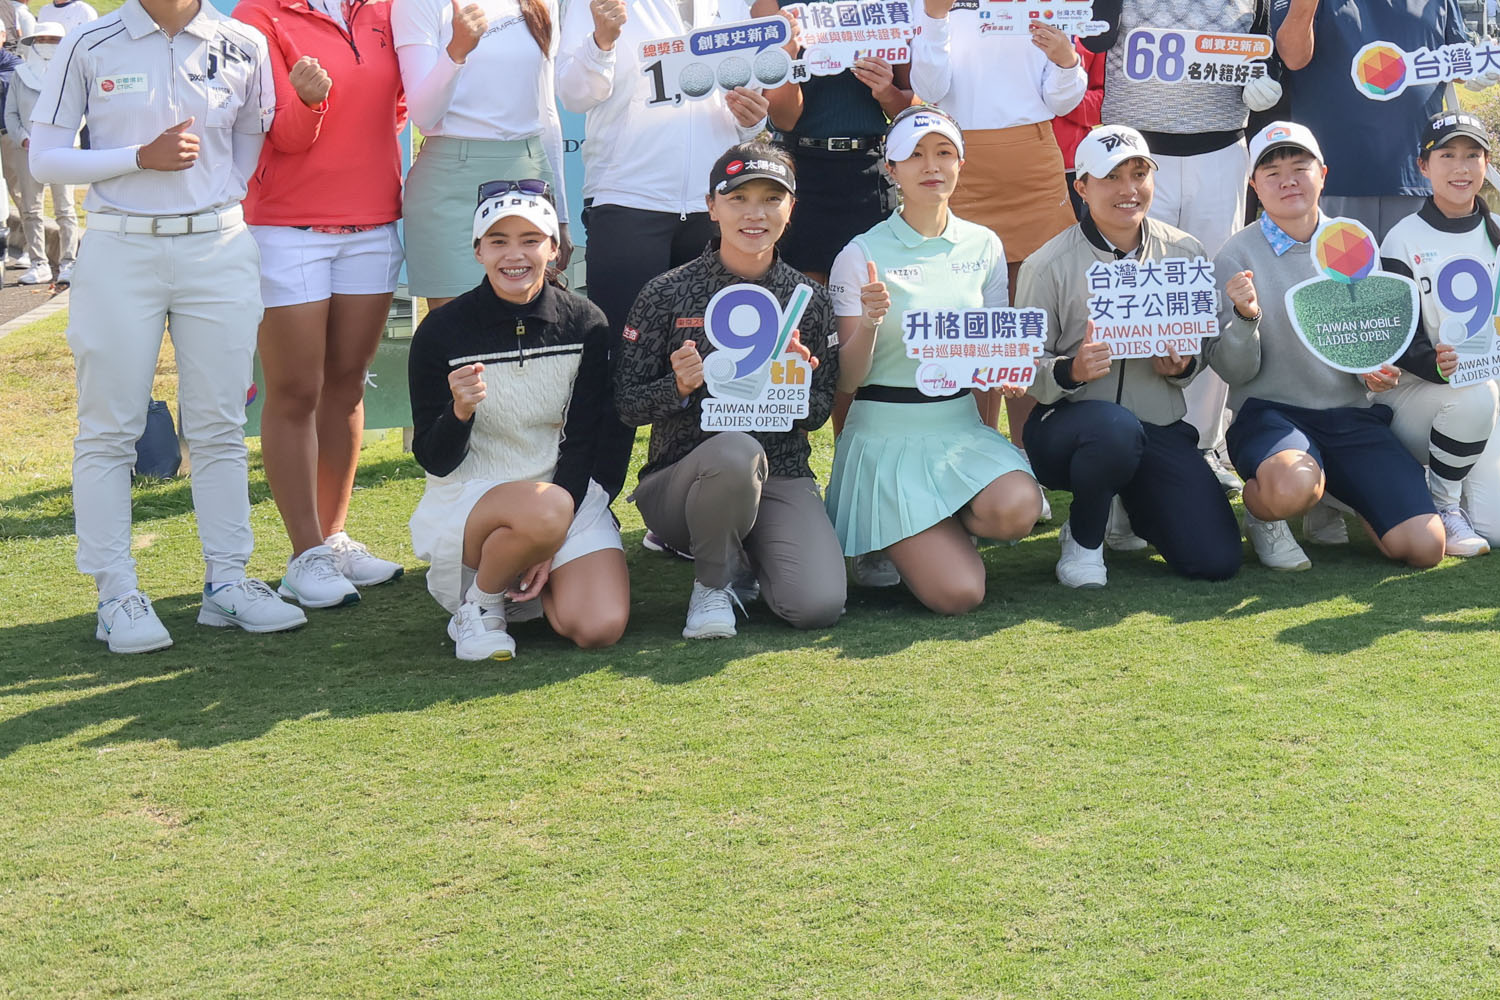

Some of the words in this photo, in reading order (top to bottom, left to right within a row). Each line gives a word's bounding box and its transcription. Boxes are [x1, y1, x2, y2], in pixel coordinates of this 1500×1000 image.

[697, 25, 780, 51] 創賽史新高
[1200, 37, 1265, 53] 創賽史新高
[643, 39, 686, 58] 總獎金
[1126, 30, 1186, 82] 68
[791, 64, 807, 79] 萬
[1188, 62, 1265, 83] 名外籍好手
[1089, 259, 1213, 290] 台灣大哥大
[1091, 290, 1214, 320] 女子公開賽
[906, 310, 1044, 340] 升格國際賽
[1095, 323, 1152, 340] TAIWAN
[1158, 321, 1216, 336] MOBILE
[1315, 320, 1357, 334] TAIWAN
[1360, 316, 1401, 330] MOBILE
[1318, 332, 1358, 347] LADIES
[1360, 330, 1391, 342] OPEN
[922, 343, 1030, 359] 台巡與韓巡共證賽
[1108, 340, 1151, 356] ADIES
[1457, 357, 1489, 372] AIWAN
[972, 366, 1033, 387] KLPGA
[1454, 368, 1490, 385] LADIES
[767, 388, 806, 401] 2025
[707, 403, 755, 415] TAIWAN
[758, 403, 804, 415] MOBILE
[706, 416, 752, 427] LADIES
[755, 416, 789, 427] OPEN
